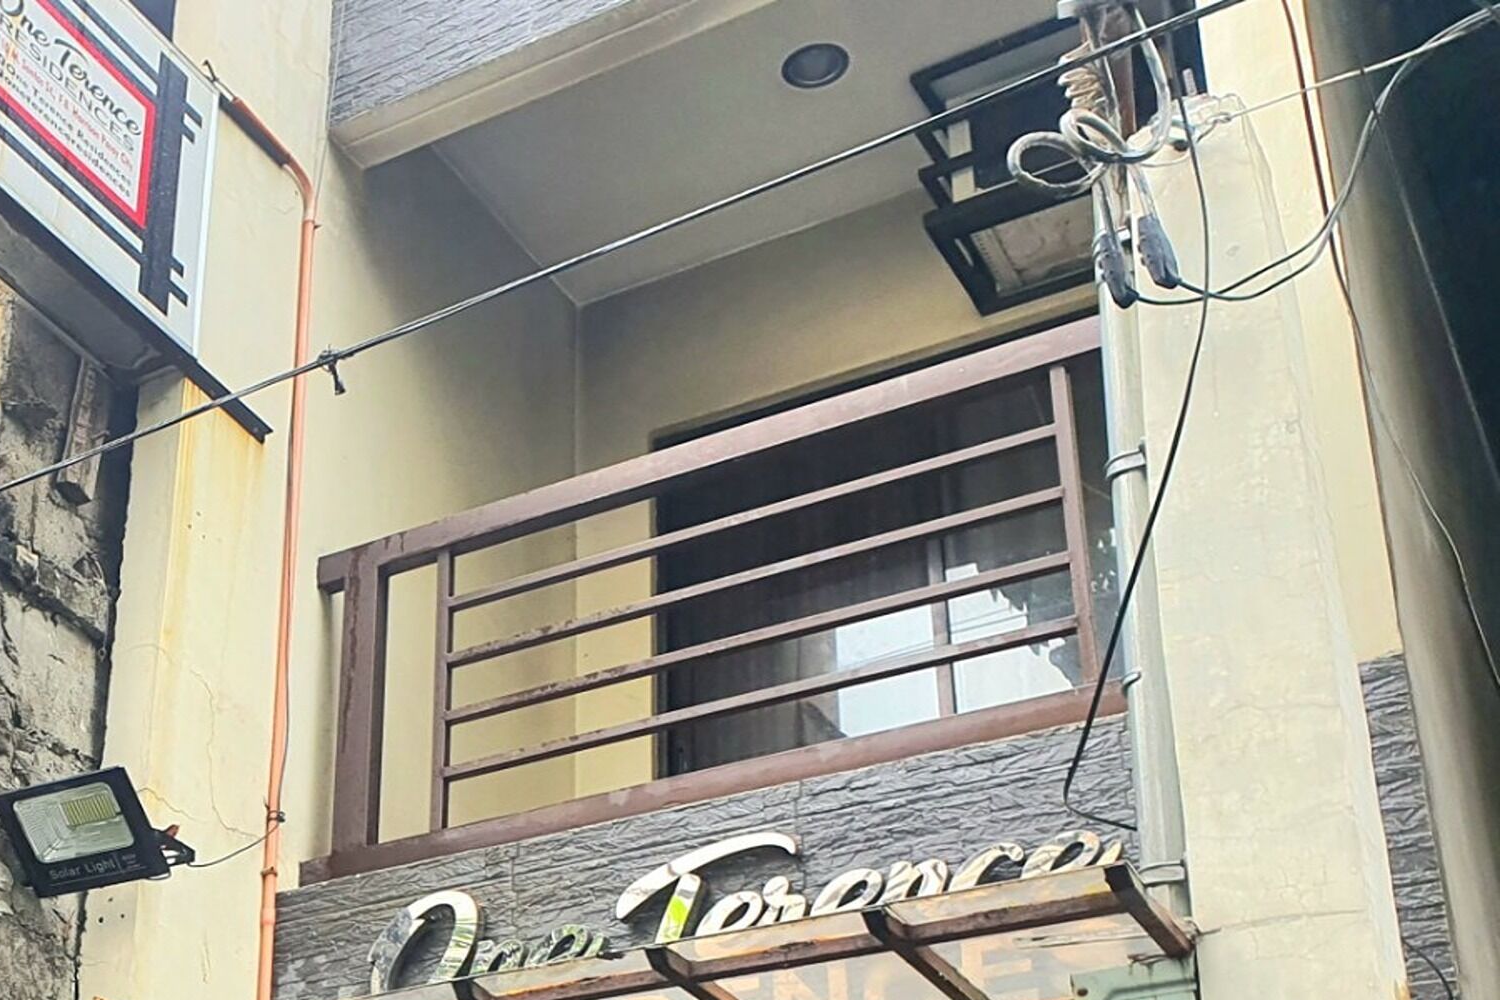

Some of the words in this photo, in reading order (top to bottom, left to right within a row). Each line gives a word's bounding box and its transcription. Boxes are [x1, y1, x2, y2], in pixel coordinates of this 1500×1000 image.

[0, 0, 51, 47] One
[54, 38, 142, 136] Terence
[0, 14, 135, 152] RESIDENCES
[49, 865, 83, 881] Solar
[84, 857, 117, 876] Light
[615, 831, 1125, 948] Terence
